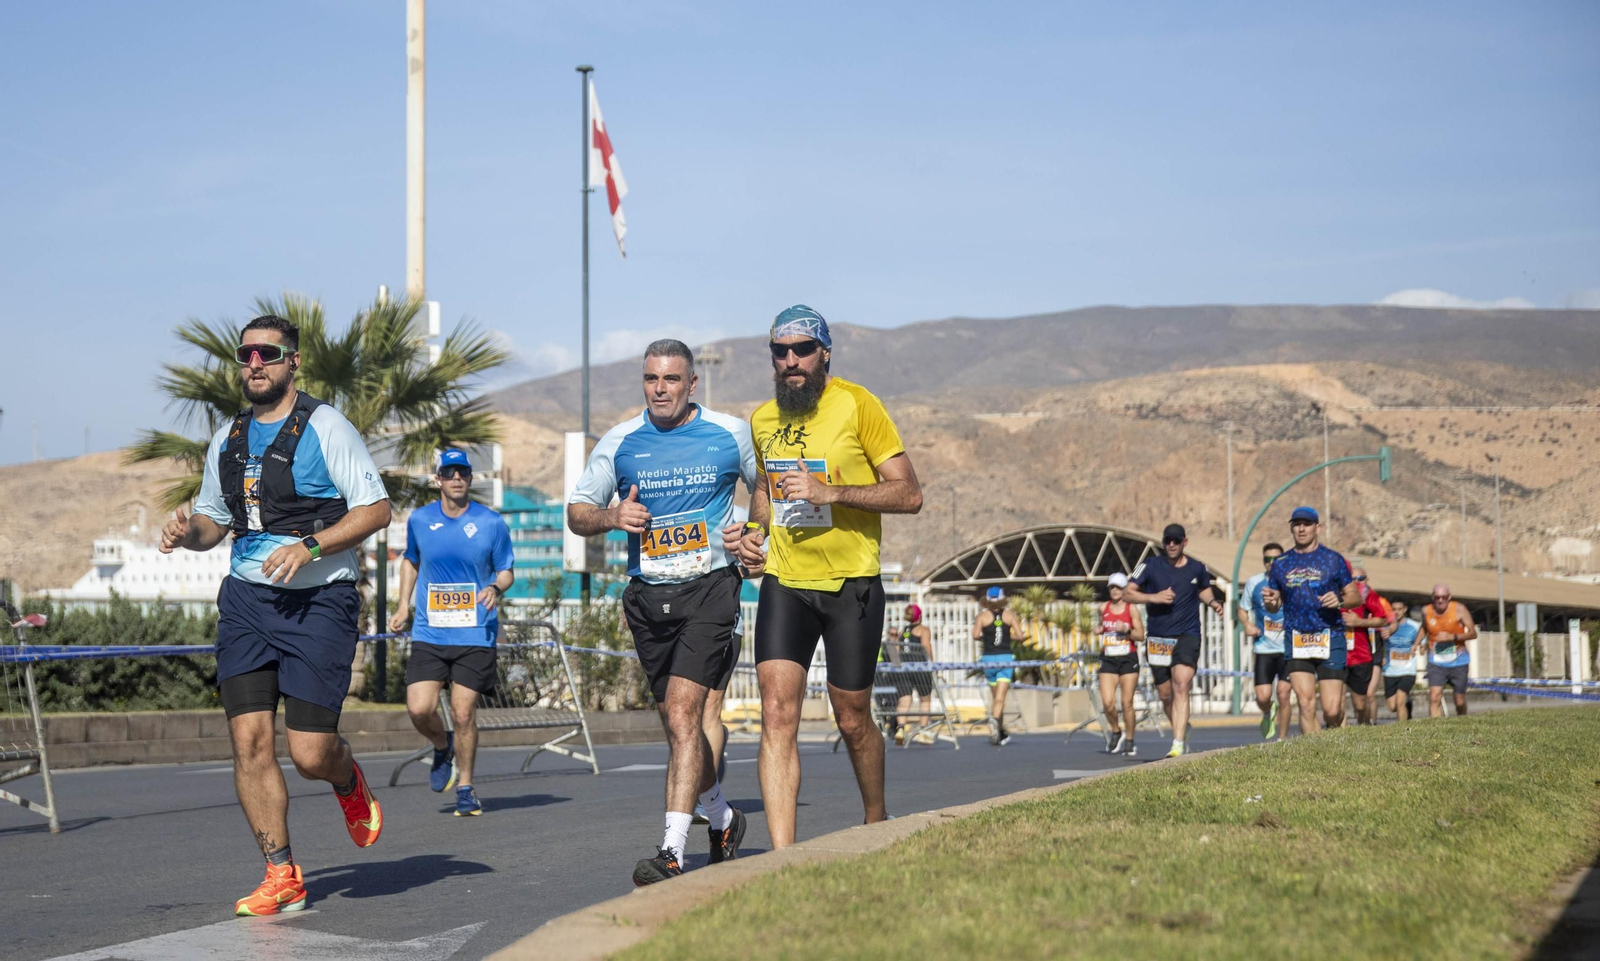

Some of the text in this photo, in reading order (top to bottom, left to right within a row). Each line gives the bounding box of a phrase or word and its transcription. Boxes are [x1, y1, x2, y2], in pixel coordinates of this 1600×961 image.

[637, 464, 718, 479] Medio Maratón
[639, 473, 717, 490] Almería 2025
[640, 491, 664, 499] RAMÓN
[684, 486, 716, 495] ANDÚJAR
[647, 522, 702, 550] 1464
[434, 592, 471, 605] 1999
